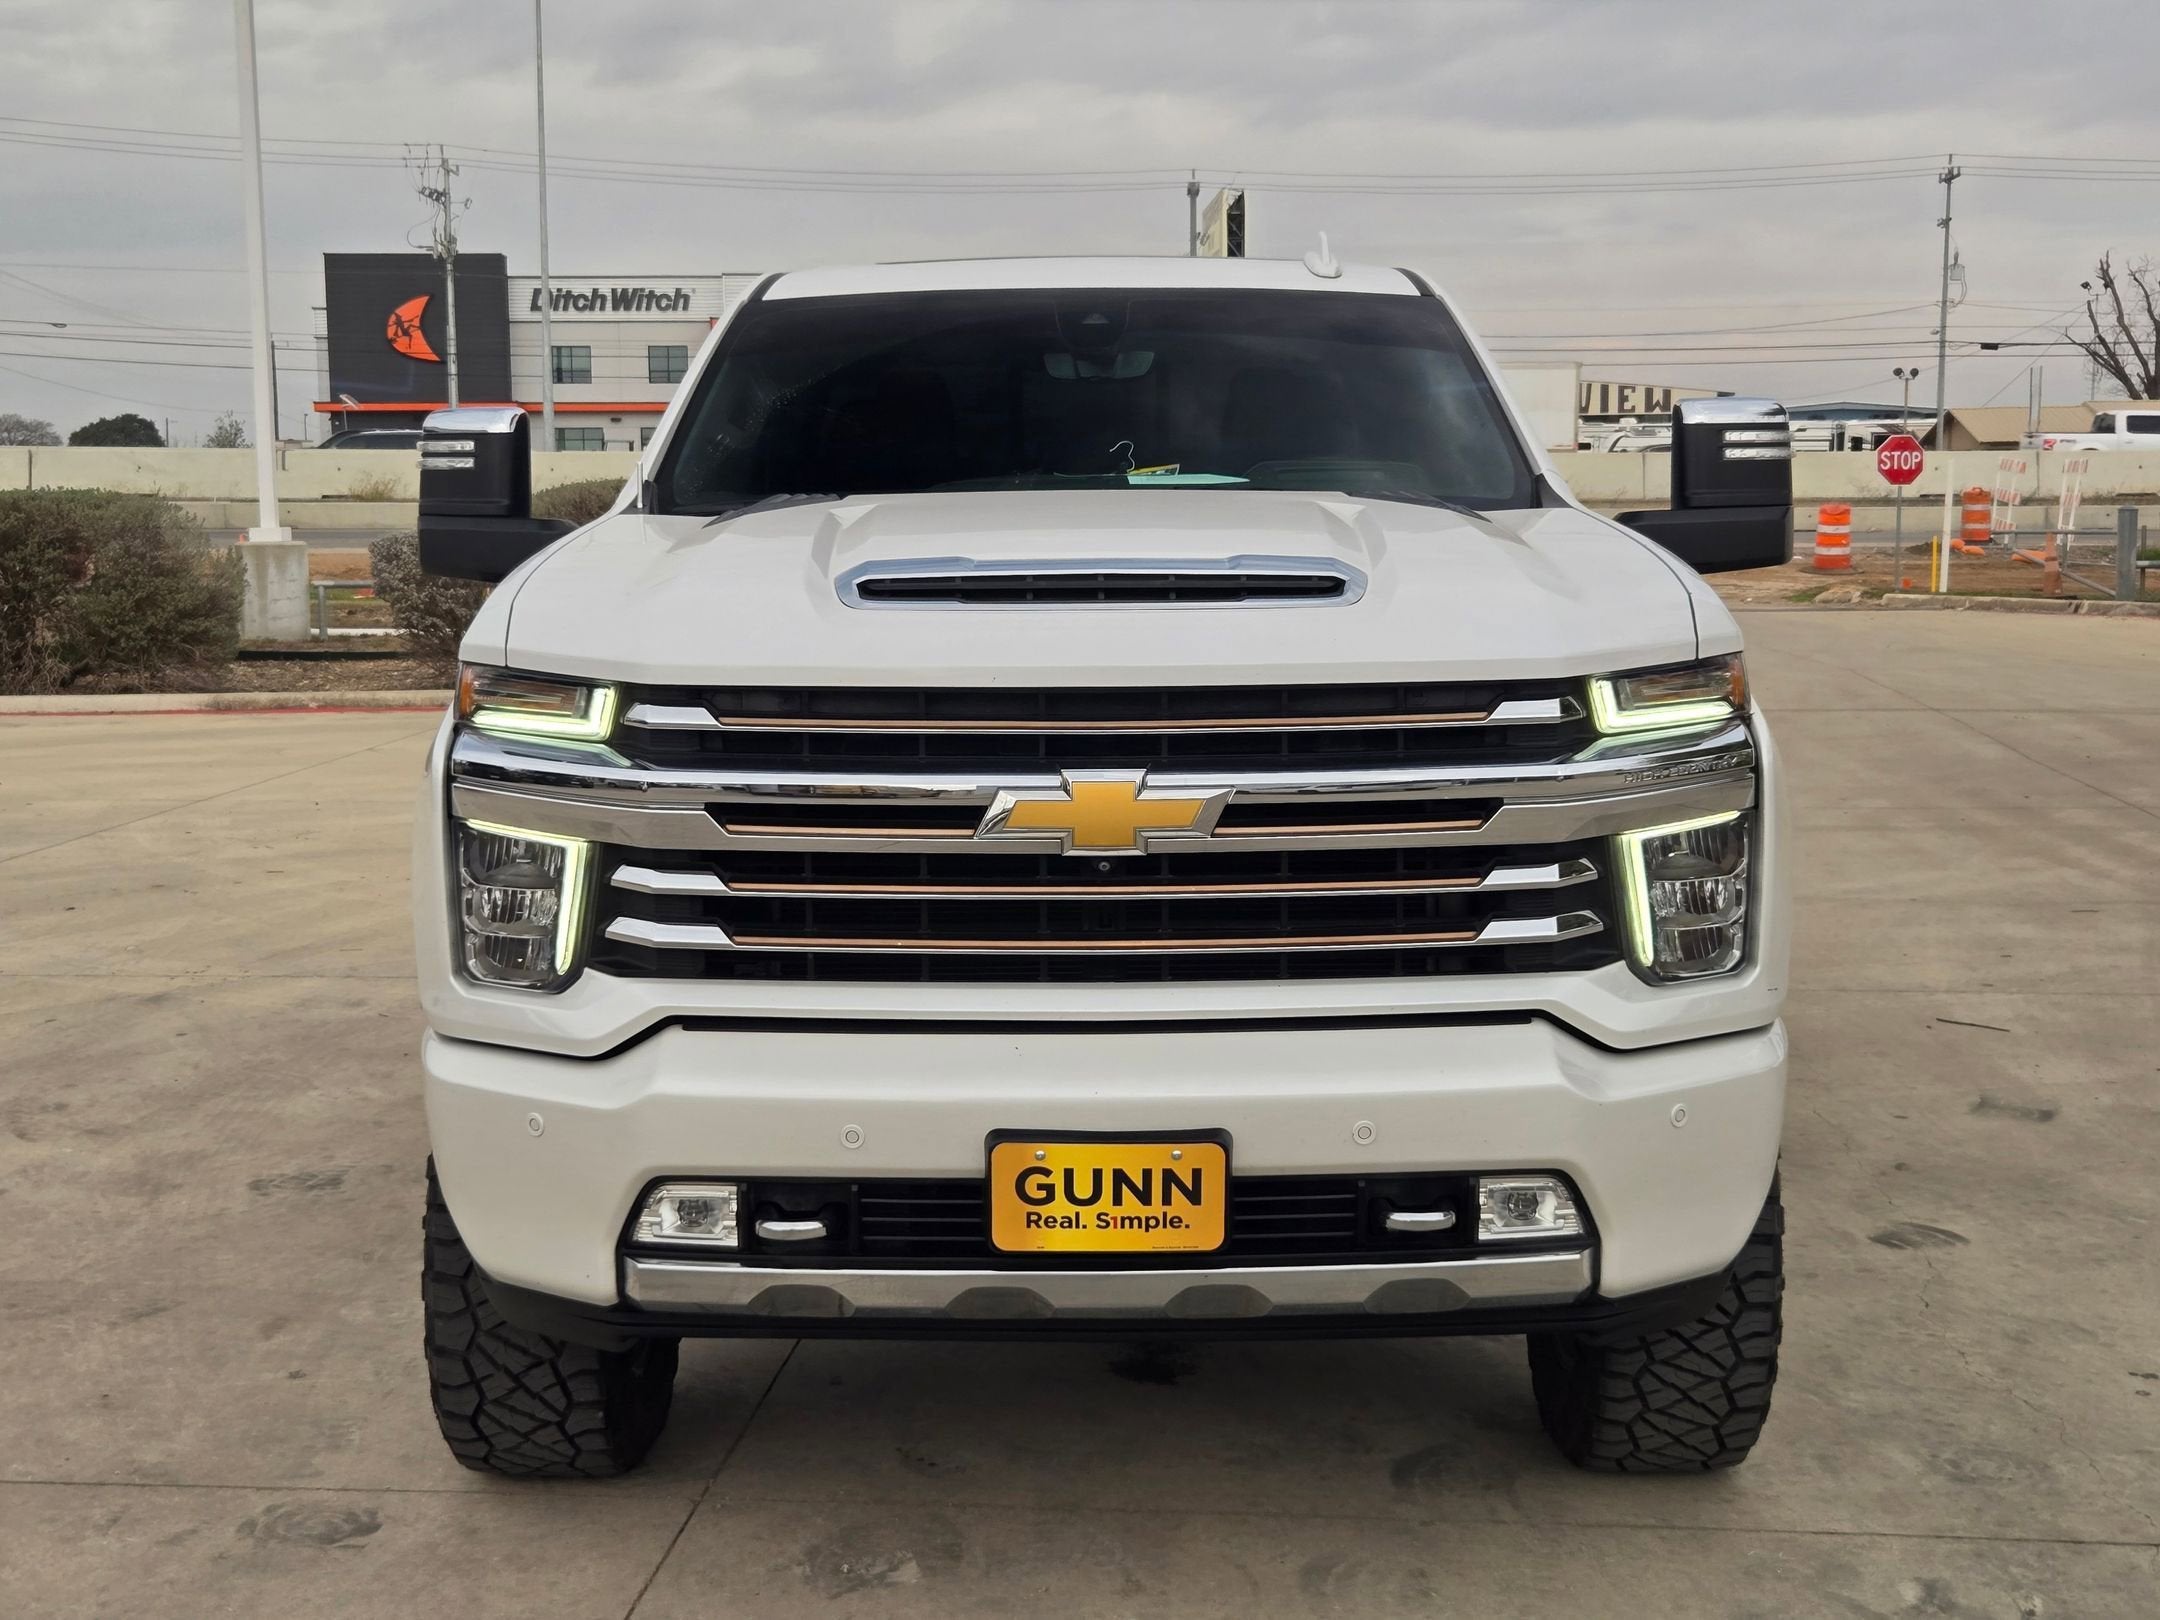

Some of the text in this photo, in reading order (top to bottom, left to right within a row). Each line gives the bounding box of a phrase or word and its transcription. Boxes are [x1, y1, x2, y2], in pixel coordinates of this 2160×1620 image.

[530, 288, 691, 311] Ditch Witch
[1579, 383, 1671, 413] VIEW
[1880, 451, 1921, 470] STOP
[1015, 1166, 1202, 1207] GUNN
[1026, 1211, 1087, 1229] Real.
